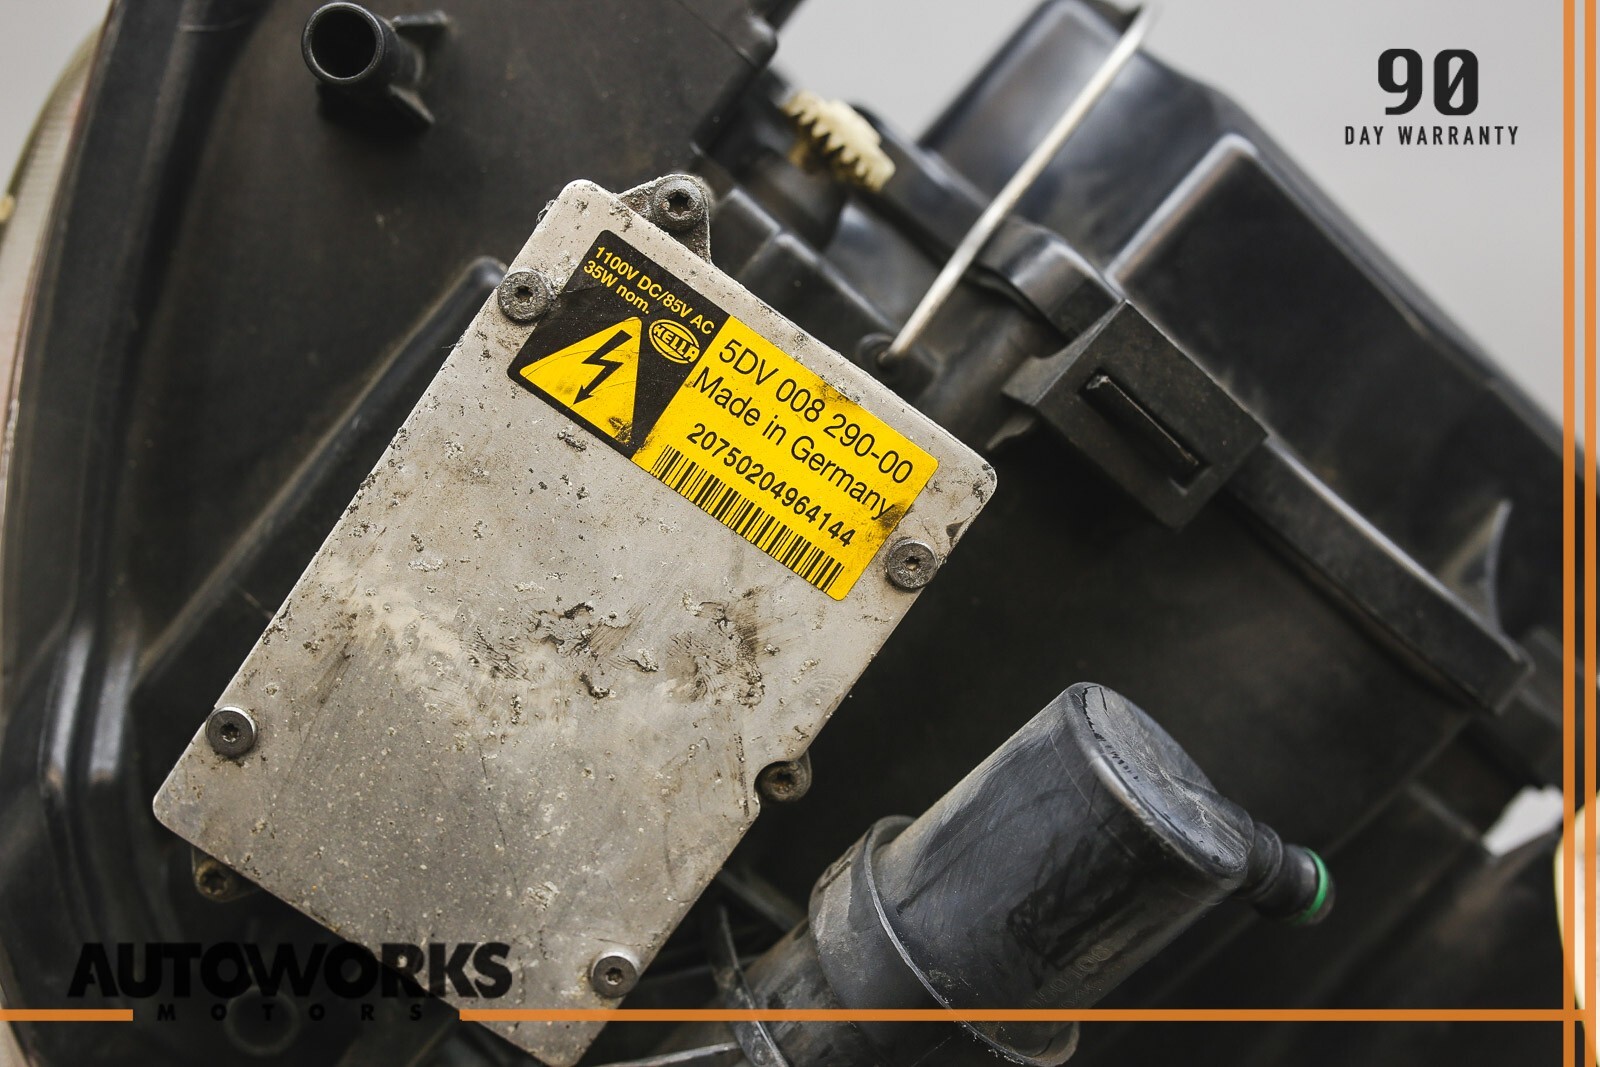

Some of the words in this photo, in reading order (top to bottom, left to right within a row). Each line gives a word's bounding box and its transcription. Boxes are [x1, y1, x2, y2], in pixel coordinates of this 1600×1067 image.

[583, 260, 619, 288] 35W
[615, 286, 651, 315] nom.
[595, 246, 640, 281] 1100V
[636, 275, 693, 318] DC/85V
[689, 313, 715, 335] AC
[652, 324, 700, 364] HELLA
[692, 366, 761, 426] Made
[762, 414, 787, 446] in
[790, 435, 897, 522] Germany
[718, 339, 779, 386] 5DV
[775, 378, 826, 423] 008
[823, 413, 914, 484] 290-00
[686, 422, 857, 548] 20750204964144
